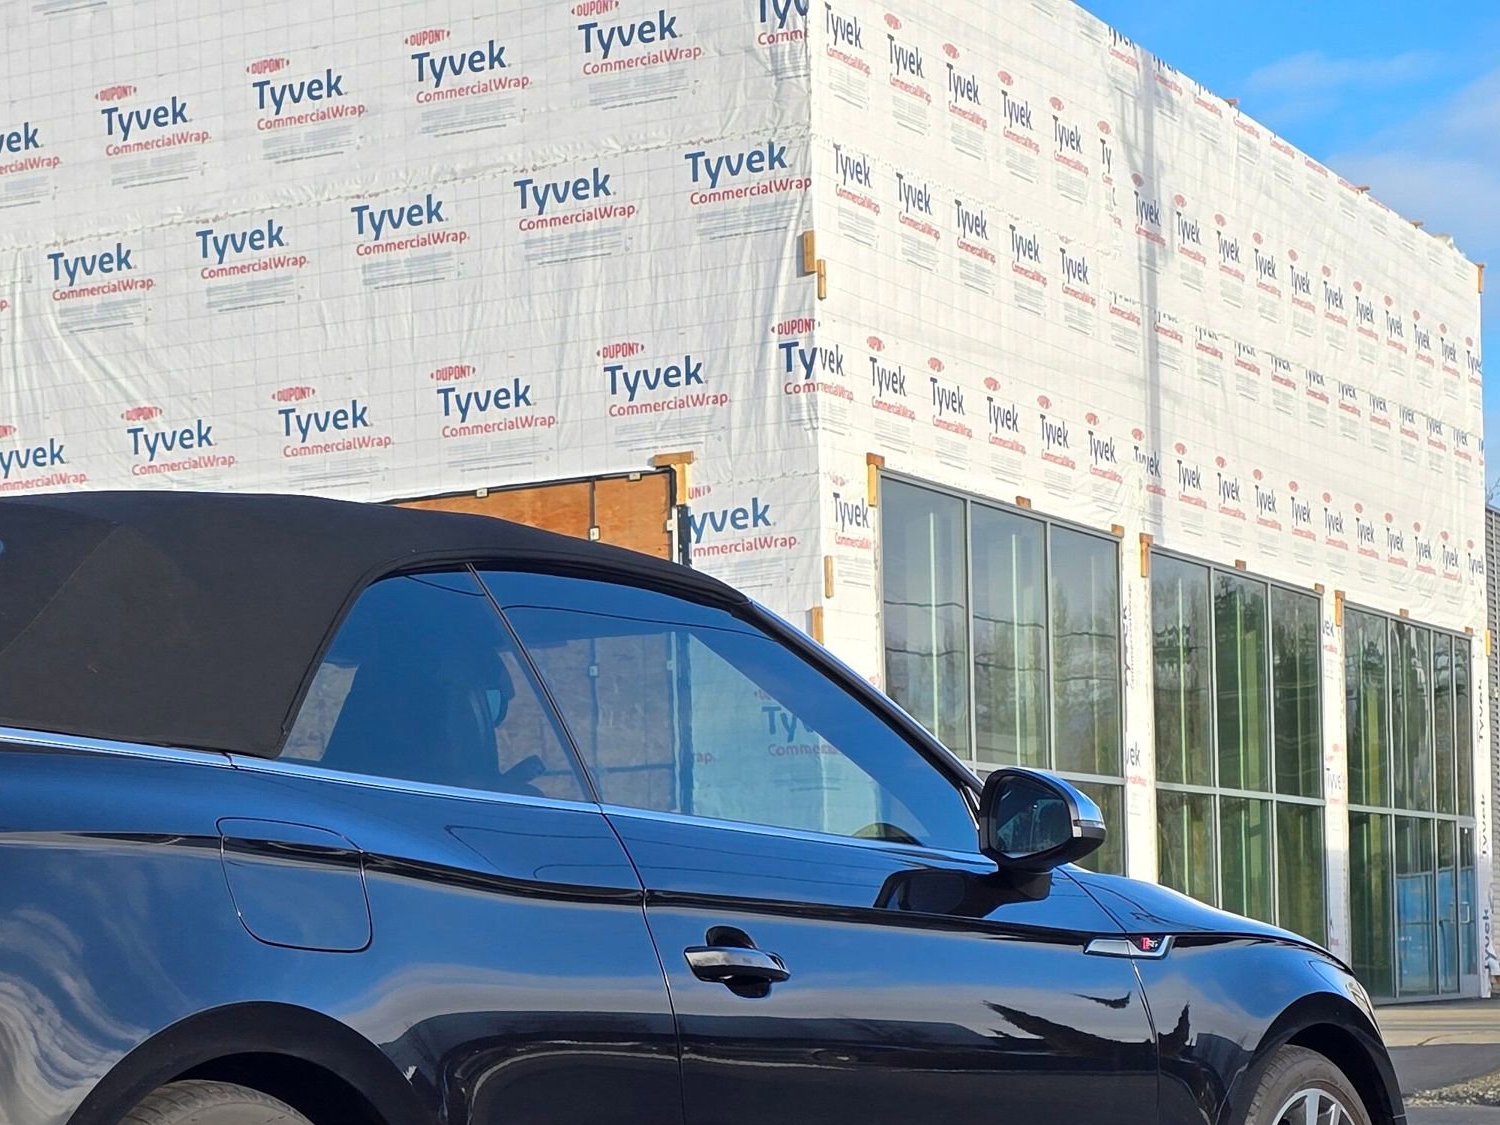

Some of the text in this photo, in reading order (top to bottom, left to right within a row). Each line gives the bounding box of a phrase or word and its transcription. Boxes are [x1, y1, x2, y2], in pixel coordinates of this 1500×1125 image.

[760, 0, 808, 28] Tyv
[825, 2, 862, 49] Tyvek
[409, 29, 446, 46] DUPONT
[578, 10, 682, 59] Tyvek
[251, 58, 285, 74] DUPONT
[411, 40, 510, 88] Tyvek
[583, 47, 701, 75] CommercialWrap
[888, 34, 924, 79] Tyvek
[99, 85, 132, 101] DUPONT
[253, 69, 347, 115] Tyvek
[416, 76, 532, 103] CommercialWrap
[947, 63, 981, 106] Tyvek
[101, 96, 191, 141] Tyvek
[257, 104, 368, 131] CommercialWrap
[1002, 90, 1033, 130] Tyvek
[106, 131, 211, 156] CommercialWrap
[1053, 115, 1081, 152] Tyvek
[685, 142, 789, 189] Tyvek
[833, 144, 871, 188] Tyvek
[514, 168, 615, 215] Tyvek
[690, 176, 812, 205] CommercialWrap
[896, 173, 932, 215] Tyvek
[351, 194, 447, 241] Tyvek
[519, 205, 638, 231] CommercialWrap
[955, 200, 988, 241] Tyvek
[1134, 190, 1161, 227] Tyvek
[196, 219, 284, 264] Tyvek
[356, 230, 469, 256] CommercialWrap
[1176, 211, 1201, 245] Tyvek
[1010, 225, 1040, 263] Tyvek
[1216, 230, 1240, 263] Tyvek
[47, 243, 132, 286] Tyvek
[201, 256, 308, 279] CommercialWrap
[1060, 248, 1089, 285] Tyvek
[1254, 248, 1276, 279] Tyvek
[52, 278, 155, 301] CommercialWrap
[1290, 265, 1310, 295] Tyvek
[1323, 281, 1343, 310] Tyvek
[1355, 296, 1374, 324] Tyvek
[777, 318, 816, 336] DUPONT
[1386, 310, 1403, 337] Tyvek
[1414, 324, 1430, 351] Tyvek
[601, 342, 639, 360] DUPONT
[779, 341, 844, 380] Tyvek
[1440, 337, 1457, 363] Tyvek
[435, 364, 471, 381] DUPONT
[604, 355, 703, 402] Tyvek
[870, 357, 907, 398] Tyvek
[276, 386, 311, 402] DUPONT
[437, 378, 531, 423] Tyvek
[609, 392, 731, 417] CommercialWrap
[930, 377, 965, 417] Tyvek
[278, 400, 368, 443] Tyvek
[442, 415, 557, 438] CommercialWrap
[987, 397, 1019, 434] Tyvek
[127, 419, 213, 461] Tyvek
[283, 435, 394, 457] CommercialWrap
[1040, 414, 1069, 450] Tyvek
[1088, 431, 1117, 465] Tyvek
[132, 455, 237, 476] CommercialWrap
[1177, 460, 1201, 491] Tyvek
[1218, 473, 1240, 503] Tyvek
[1255, 485, 1277, 515] Tyvek
[690, 497, 772, 544] yvek
[833, 493, 869, 532] Tyvek
[1290, 496, 1311, 524] Tyvek
[1324, 508, 1344, 535] Tyvek
[693, 534, 798, 557] mmercialWrap
[1356, 518, 1375, 544] Tyvek
[1386, 528, 1404, 553] Tyvek
[1415, 537, 1431, 562] Tyvek
[1442, 545, 1458, 570] Tyvek
[1468, 553, 1484, 577] Tyvek
